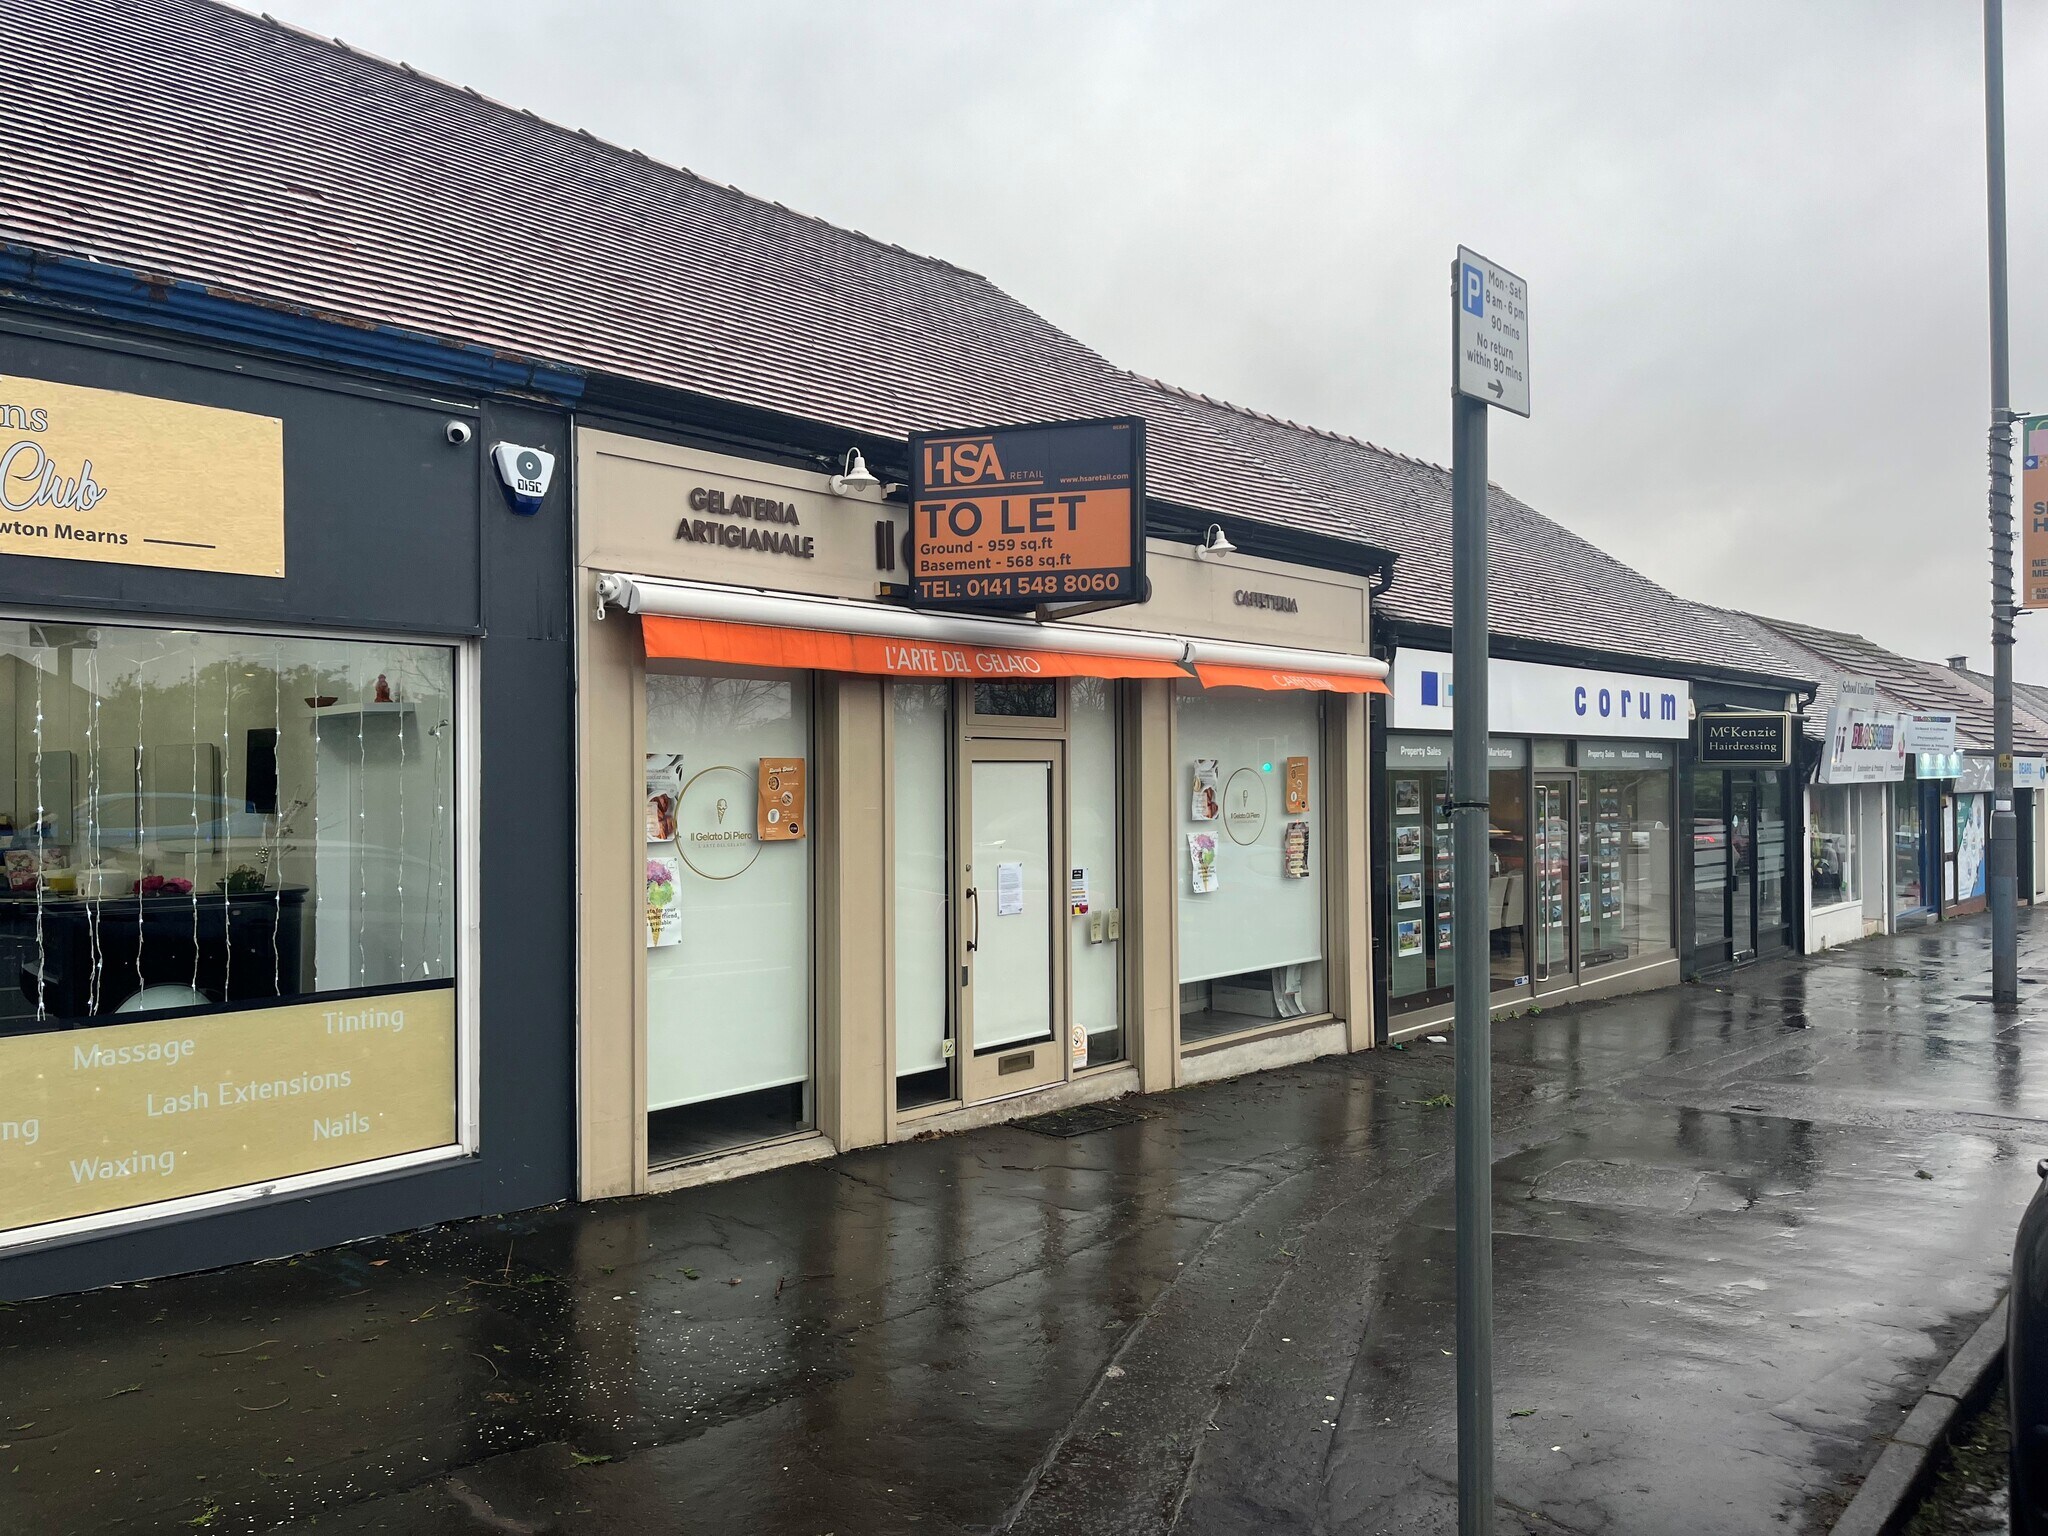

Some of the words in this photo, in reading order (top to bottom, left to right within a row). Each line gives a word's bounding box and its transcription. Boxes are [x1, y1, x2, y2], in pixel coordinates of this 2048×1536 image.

[1488, 270, 1504, 288] Mon
[1510, 282, 1522, 300] Sat
[1491, 315, 1501, 332] 90
[1503, 321, 1520, 340] mins
[1477, 332, 1488, 349] No
[1490, 340, 1513, 360] return
[1467, 349, 1491, 369] within
[1494, 360, 1504, 374] 90
[1505, 365, 1522, 382] mins
[0, 440, 107, 512] Club
[924, 443, 1005, 485] HSA
[1010, 470, 1044, 480] RETAIL
[1060, 473, 1129, 484] www.hsaretail.com
[518, 478, 542, 493] DISC
[690, 487, 800, 526] GELATERIA
[920, 501, 983, 539] TO
[1001, 494, 1086, 534] LET
[2033, 502, 2048, 515] S
[54, 524, 128, 545] Mearns
[676, 518, 815, 558] ARTIGIANALE
[920, 542, 973, 555] Ground
[988, 539, 1016, 551] 959
[1020, 537, 1053, 552] sq.ft
[920, 557, 991, 572] Basement
[1006, 556, 1033, 568] 568
[1038, 553, 1071, 568] sq.ft
[920, 581, 961, 598] TEL:
[966, 578, 1011, 596] 0141
[1018, 576, 1058, 594] 548
[1063, 573, 1120, 592] 8060
[885, 646, 938, 672] L'ARTE
[942, 650, 971, 672] DEL
[976, 653, 1040, 674] GELATO
[1842, 680, 1856, 694] School
[1858, 682, 1875, 696] Uniform
[1574, 686, 1676, 721] corum
[1710, 726, 1777, 738] McKenzie
[1400, 746, 1425, 758] Property
[1426, 747, 1442, 756] Sales
[1587, 750, 1604, 760] Property
[1646, 751, 1662, 760] Marketing
[1709, 742, 1777, 752] Hairdressing
[696, 832, 723, 841] Gelato
[724, 832, 732, 840] Di
[733, 831, 752, 840] Piero
[322, 1007, 404, 1034] Tinting
[74, 1038, 195, 1071] Massage
[147, 1086, 208, 1118] Lash
[218, 1068, 352, 1106] Extensions
[313, 1110, 370, 1142] Nails
[69, 1150, 175, 1184] Waxing
